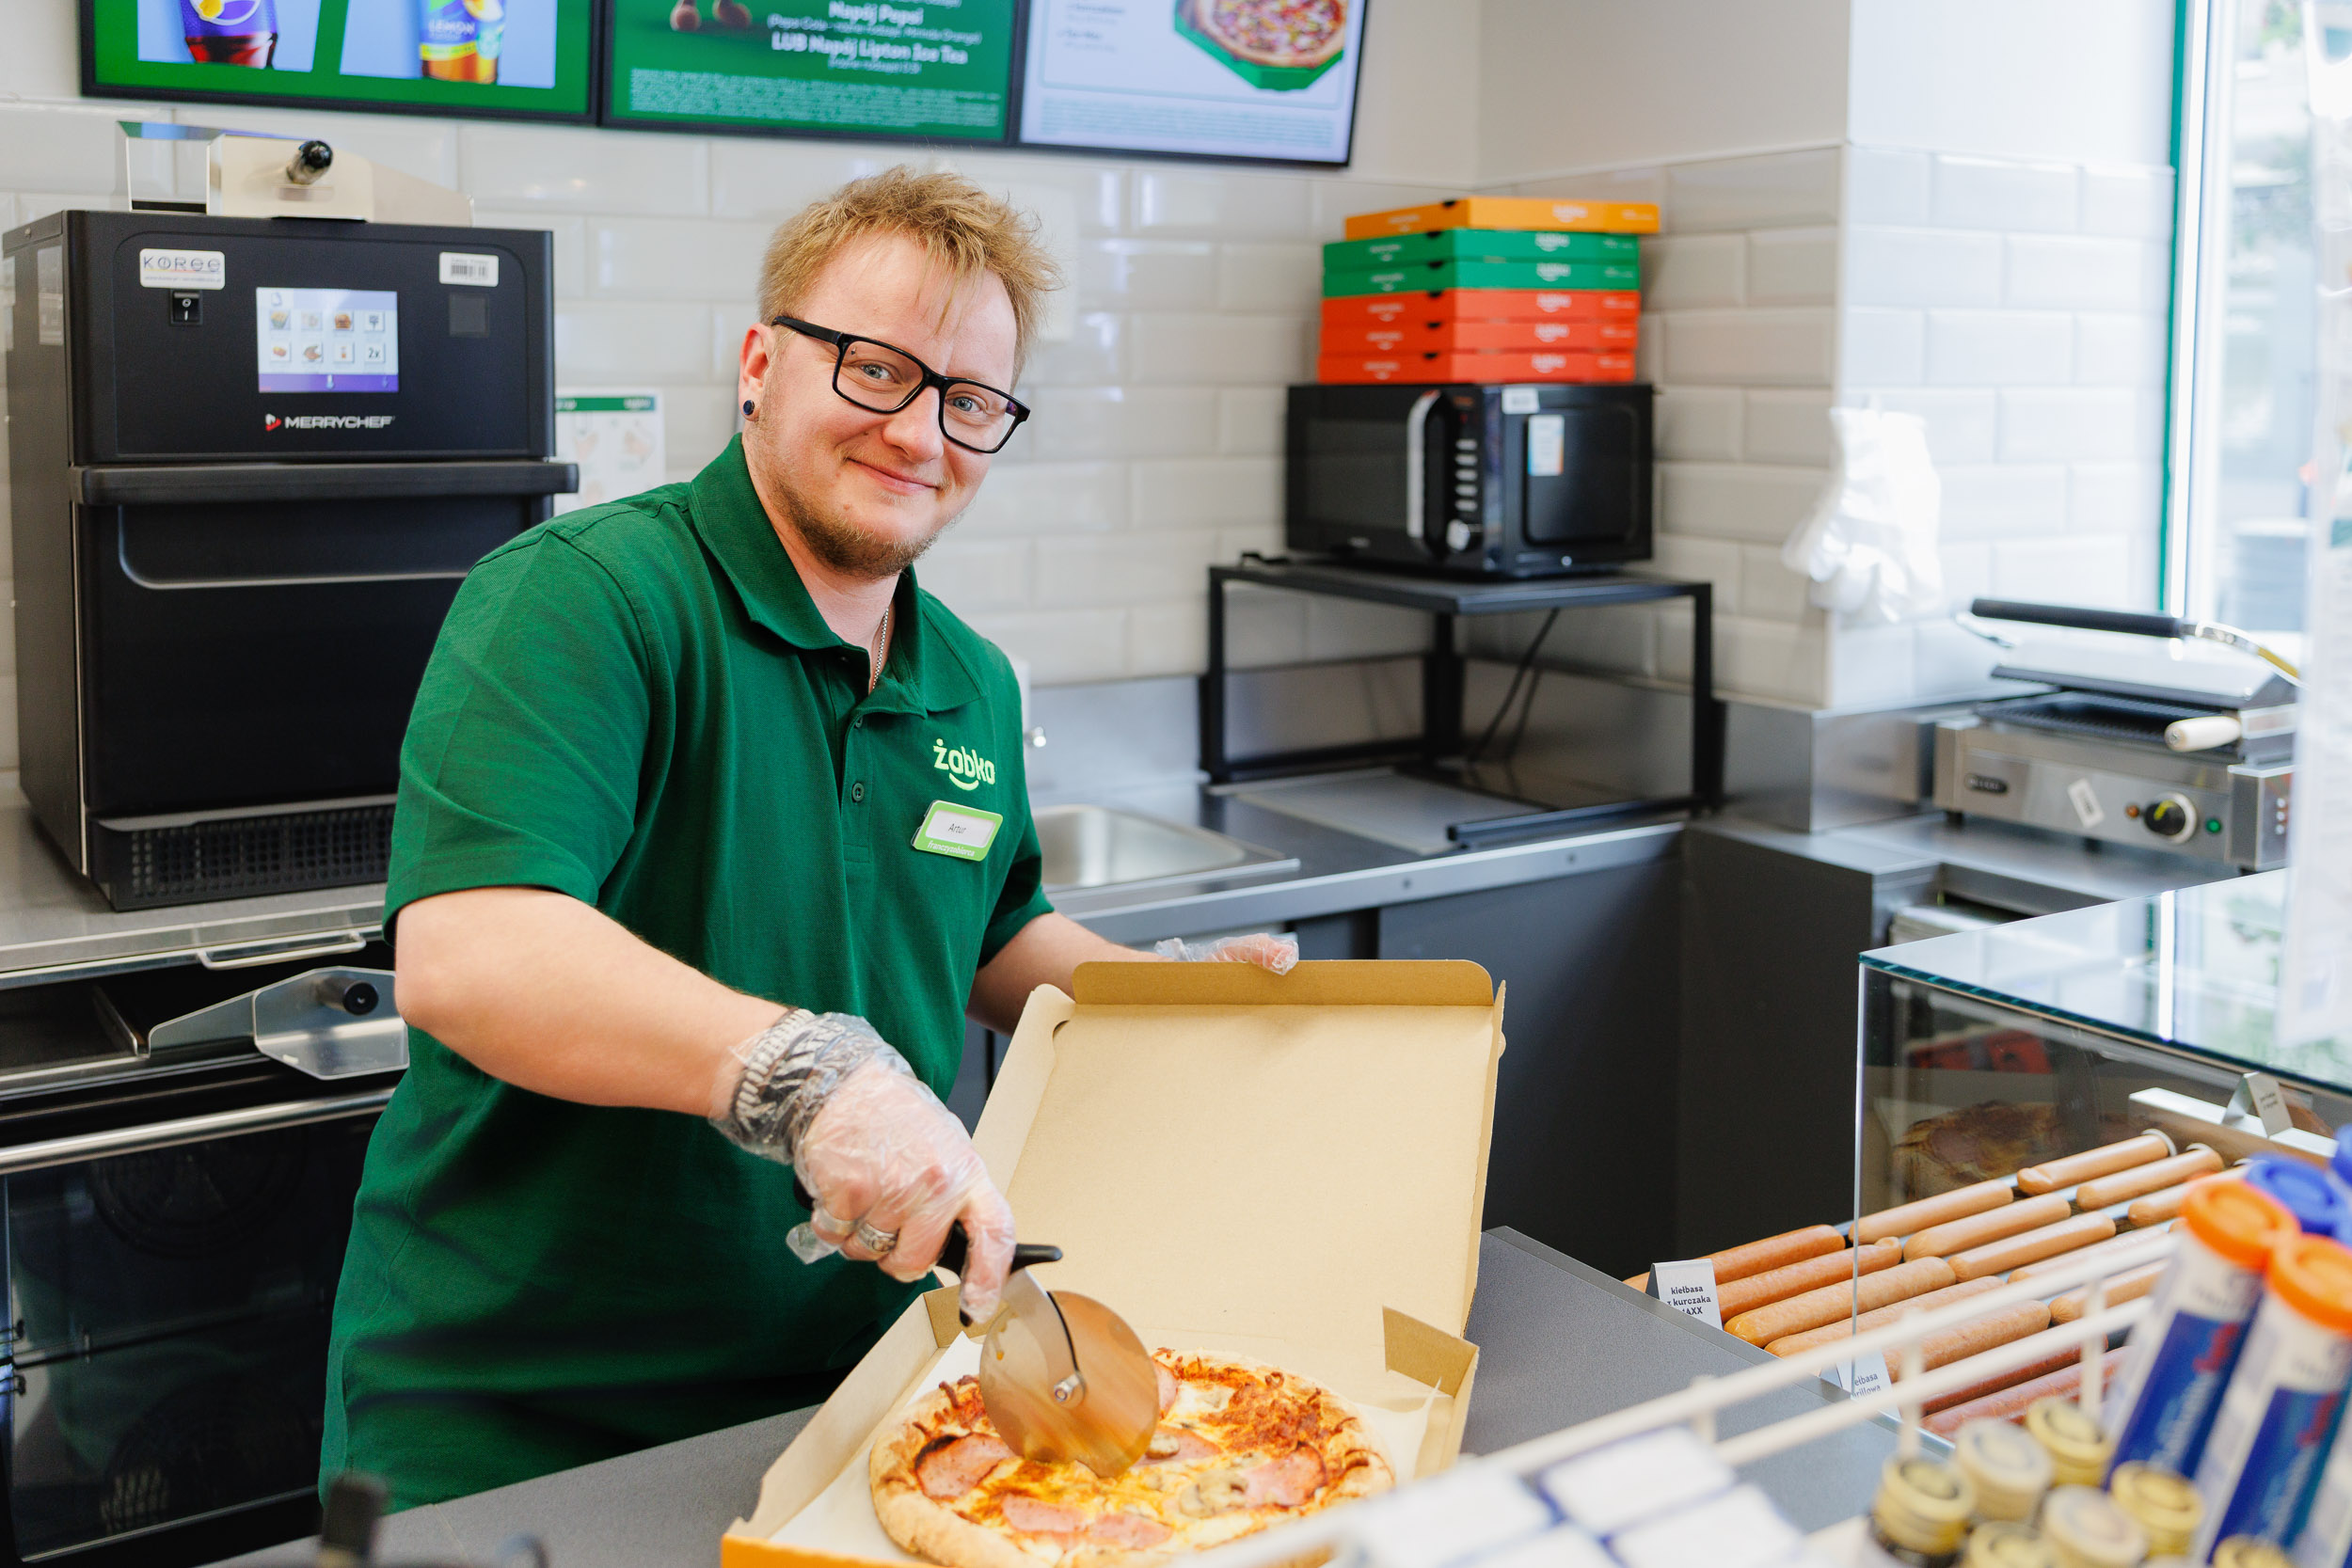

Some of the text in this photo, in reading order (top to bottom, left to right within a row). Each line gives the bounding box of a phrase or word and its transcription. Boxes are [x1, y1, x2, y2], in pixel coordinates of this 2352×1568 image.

[428, 20, 475, 35] LEMON
[771, 31, 807, 52] LUB
[284, 416, 392, 428] MERRYCHEF
[948, 823, 966, 834] Artur
[1671, 1286, 1704, 1294] kiełbasa
[1674, 1295, 1711, 1306] kurczaka
[1682, 1307, 1703, 1315] AXX
